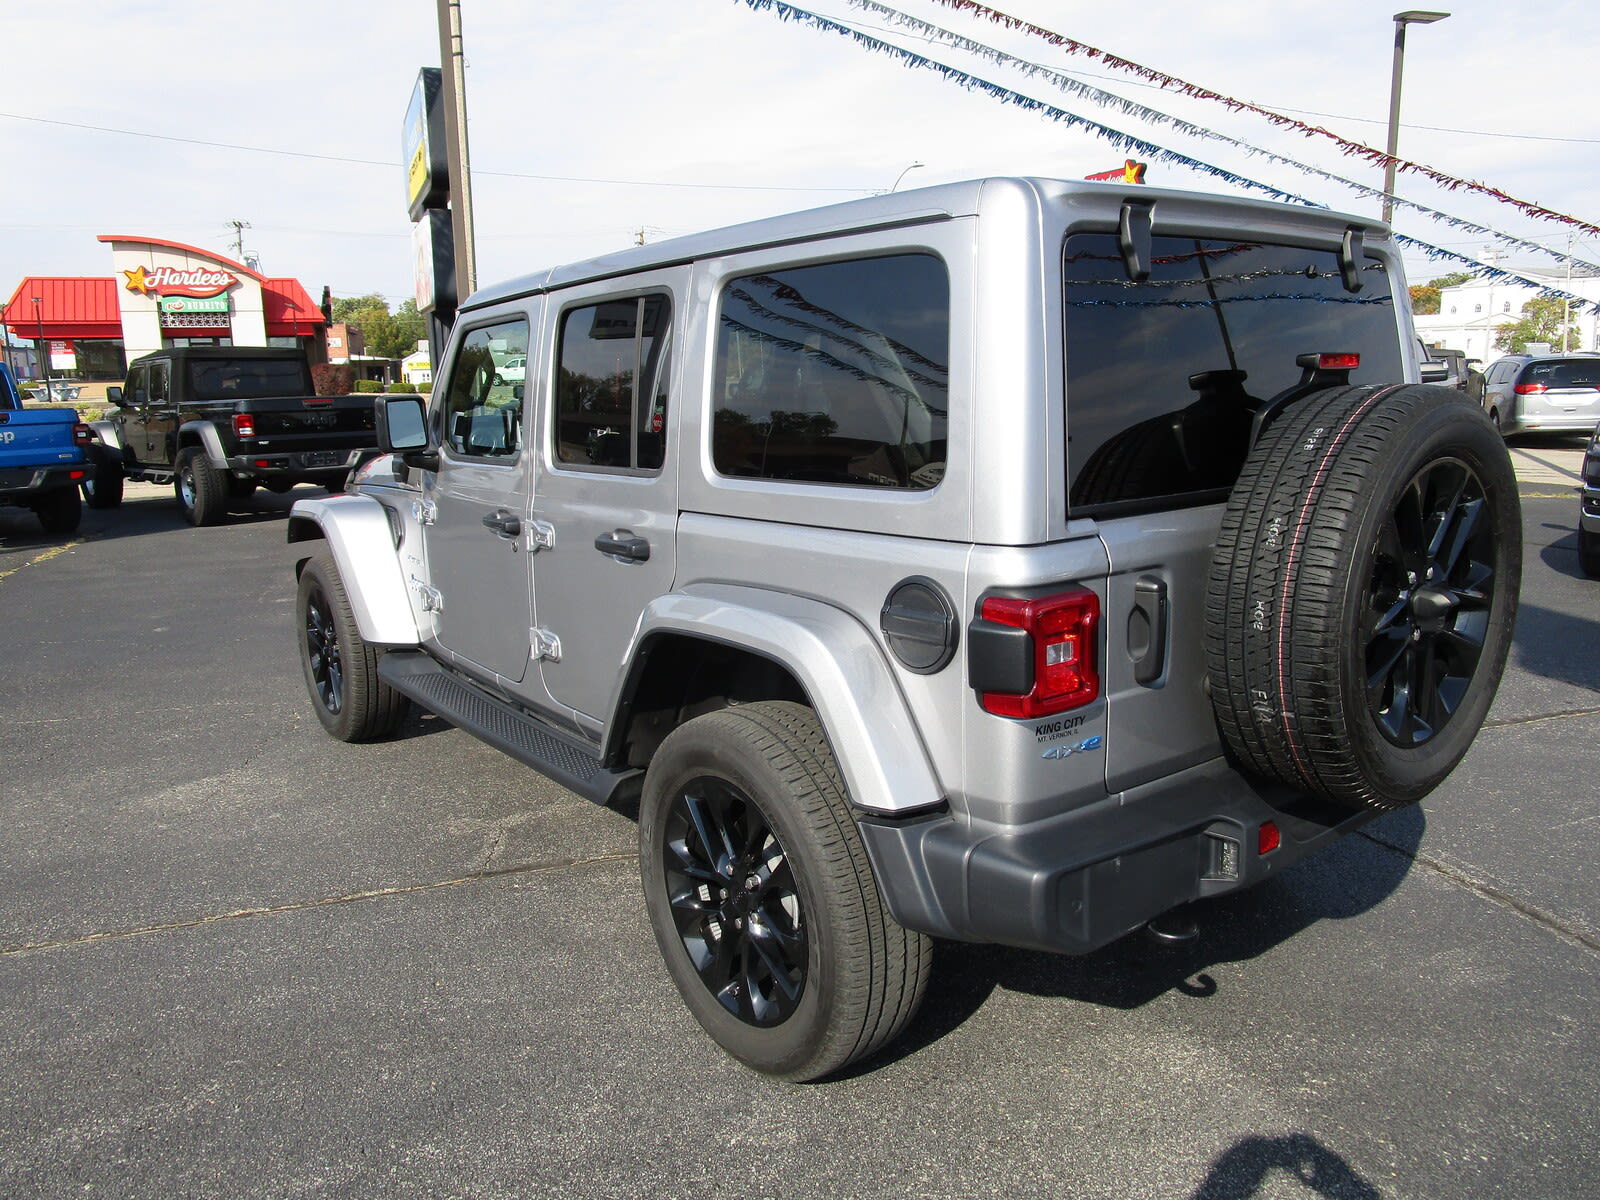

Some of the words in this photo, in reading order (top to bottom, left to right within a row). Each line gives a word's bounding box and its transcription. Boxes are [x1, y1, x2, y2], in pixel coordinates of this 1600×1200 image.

[144, 267, 233, 287] Hardee's
[187, 301, 225, 310] BURRITO
[1035, 721, 1062, 737] KING
[1063, 715, 1086, 730] CITY
